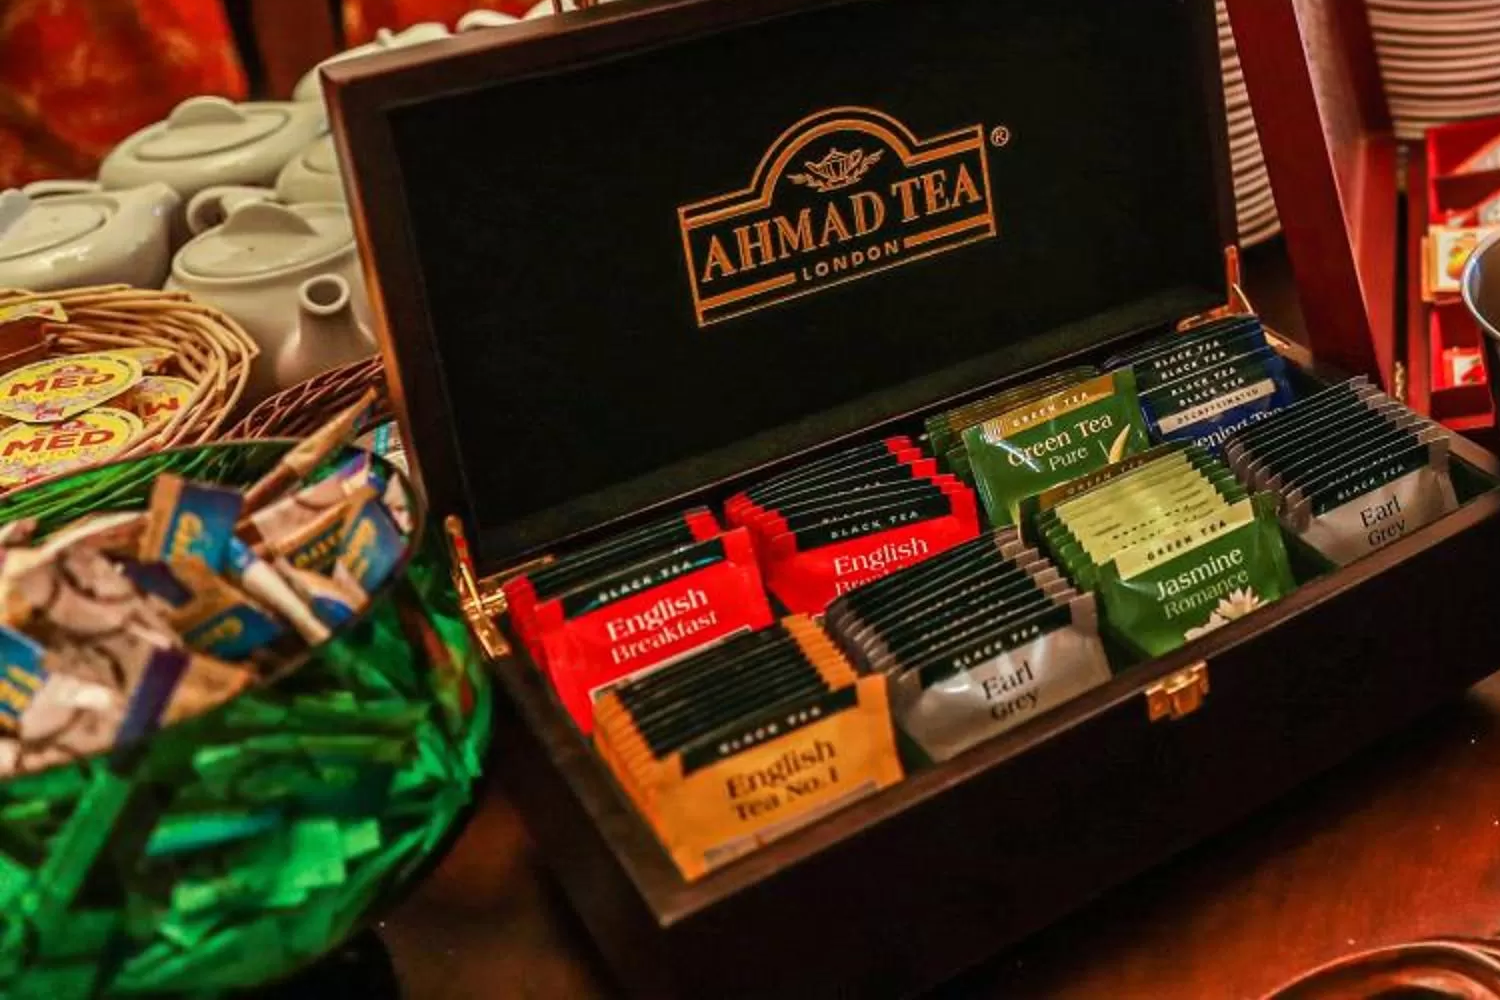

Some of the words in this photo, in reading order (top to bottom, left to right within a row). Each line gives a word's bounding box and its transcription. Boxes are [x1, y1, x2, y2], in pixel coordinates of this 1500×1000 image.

[702, 191, 885, 282] AHMAD
[891, 163, 983, 223] TEA
[802, 239, 900, 281] LONDON
[1154, 350, 1192, 369] BLACK
[1198, 340, 1220, 352] TEA
[1161, 361, 1197, 380] BLACK
[1204, 351, 1226, 363] TEA
[8, 372, 116, 397] MED
[1171, 378, 1208, 396] BLACK
[1214, 367, 1236, 379] TEA
[1179, 387, 1217, 407] BLACK
[1222, 377, 1245, 390] TEA
[1013, 404, 1056, 427] GREEN
[1064, 392, 1089, 406] TEA
[2, 428, 116, 457] MED
[1007, 431, 1072, 468] Green
[1074, 413, 1113, 438] Tea
[1048, 447, 1089, 472] Pure
[1337, 477, 1375, 500] BLACK
[1383, 464, 1404, 479] TEA
[830, 519, 881, 540] BLACK
[889, 511, 919, 524] TEA
[1360, 492, 1402, 528] Earl
[1147, 535, 1193, 561] GREEN
[1200, 520, 1227, 536] TEA
[1367, 519, 1406, 547] Grey
[833, 537, 930, 576] English
[1156, 548, 1244, 601] Jasmine
[598, 575, 652, 603] BLACK
[660, 560, 692, 578] TEA
[1163, 570, 1249, 619] Romance
[605, 588, 709, 643] English
[610, 610, 718, 665] Breakfast
[952, 641, 1003, 669] BLACK
[1011, 625, 1040, 643] TEA
[982, 659, 1034, 700] Earl
[991, 687, 1039, 721] Grey
[719, 722, 779, 754] BLACK
[787, 706, 821, 726] TEA
[726, 739, 836, 800] English
[731, 793, 780, 821] Tea
